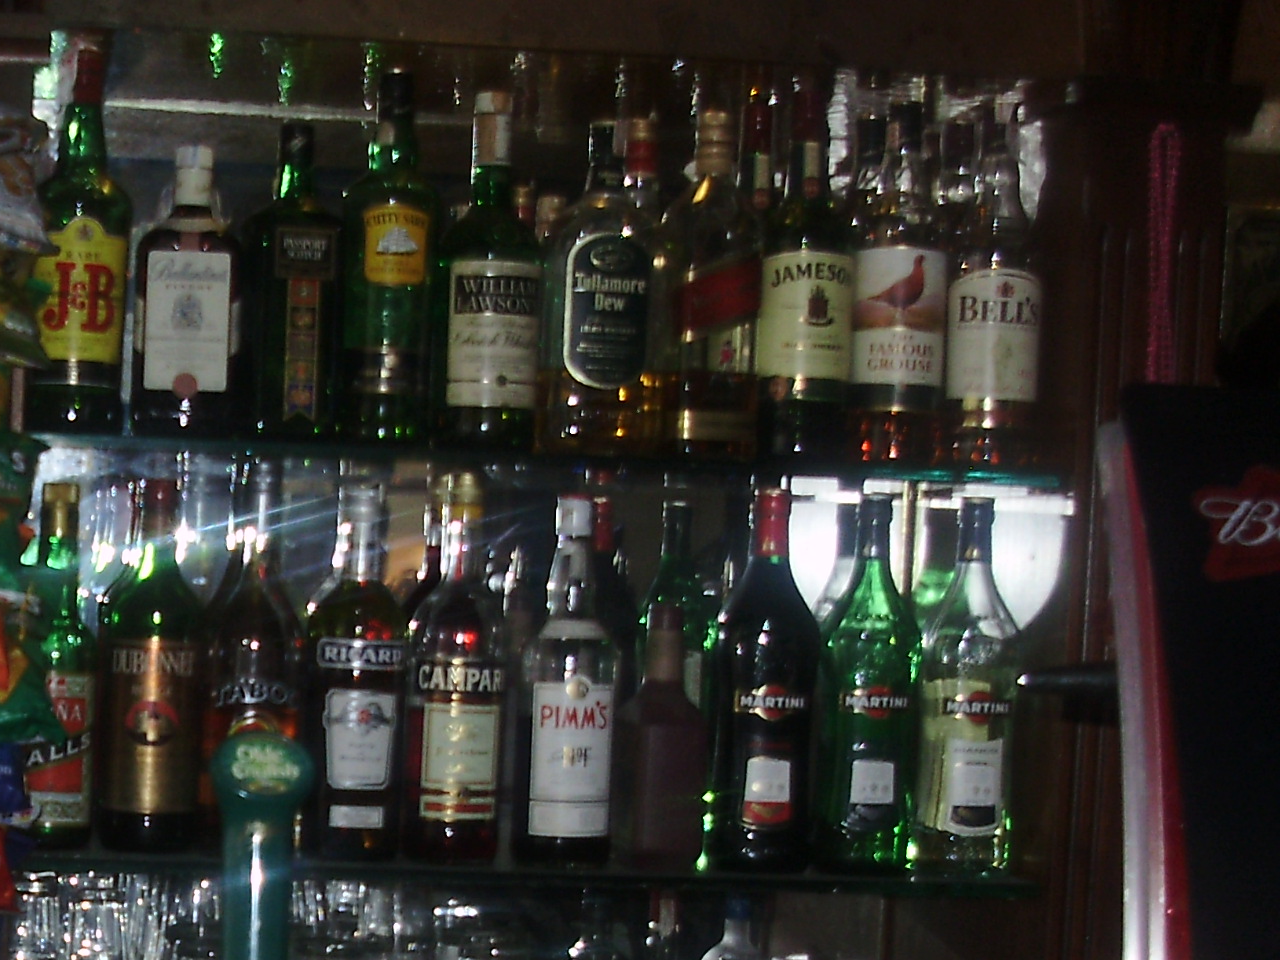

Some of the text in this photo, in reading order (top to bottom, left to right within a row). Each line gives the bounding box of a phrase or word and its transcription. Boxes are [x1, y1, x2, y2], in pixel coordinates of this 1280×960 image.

[574, 271, 647, 294] Tullamore
[42, 262, 116, 333] J&B
[594, 292, 625, 312] Dew
[959, 296, 1039, 325] BELL'S
[740, 694, 805, 710] MARTINI
[844, 694, 908, 710] MARTINI
[946, 700, 1010, 716] MARTINI
[539, 701, 608, 730] PIMM'S
